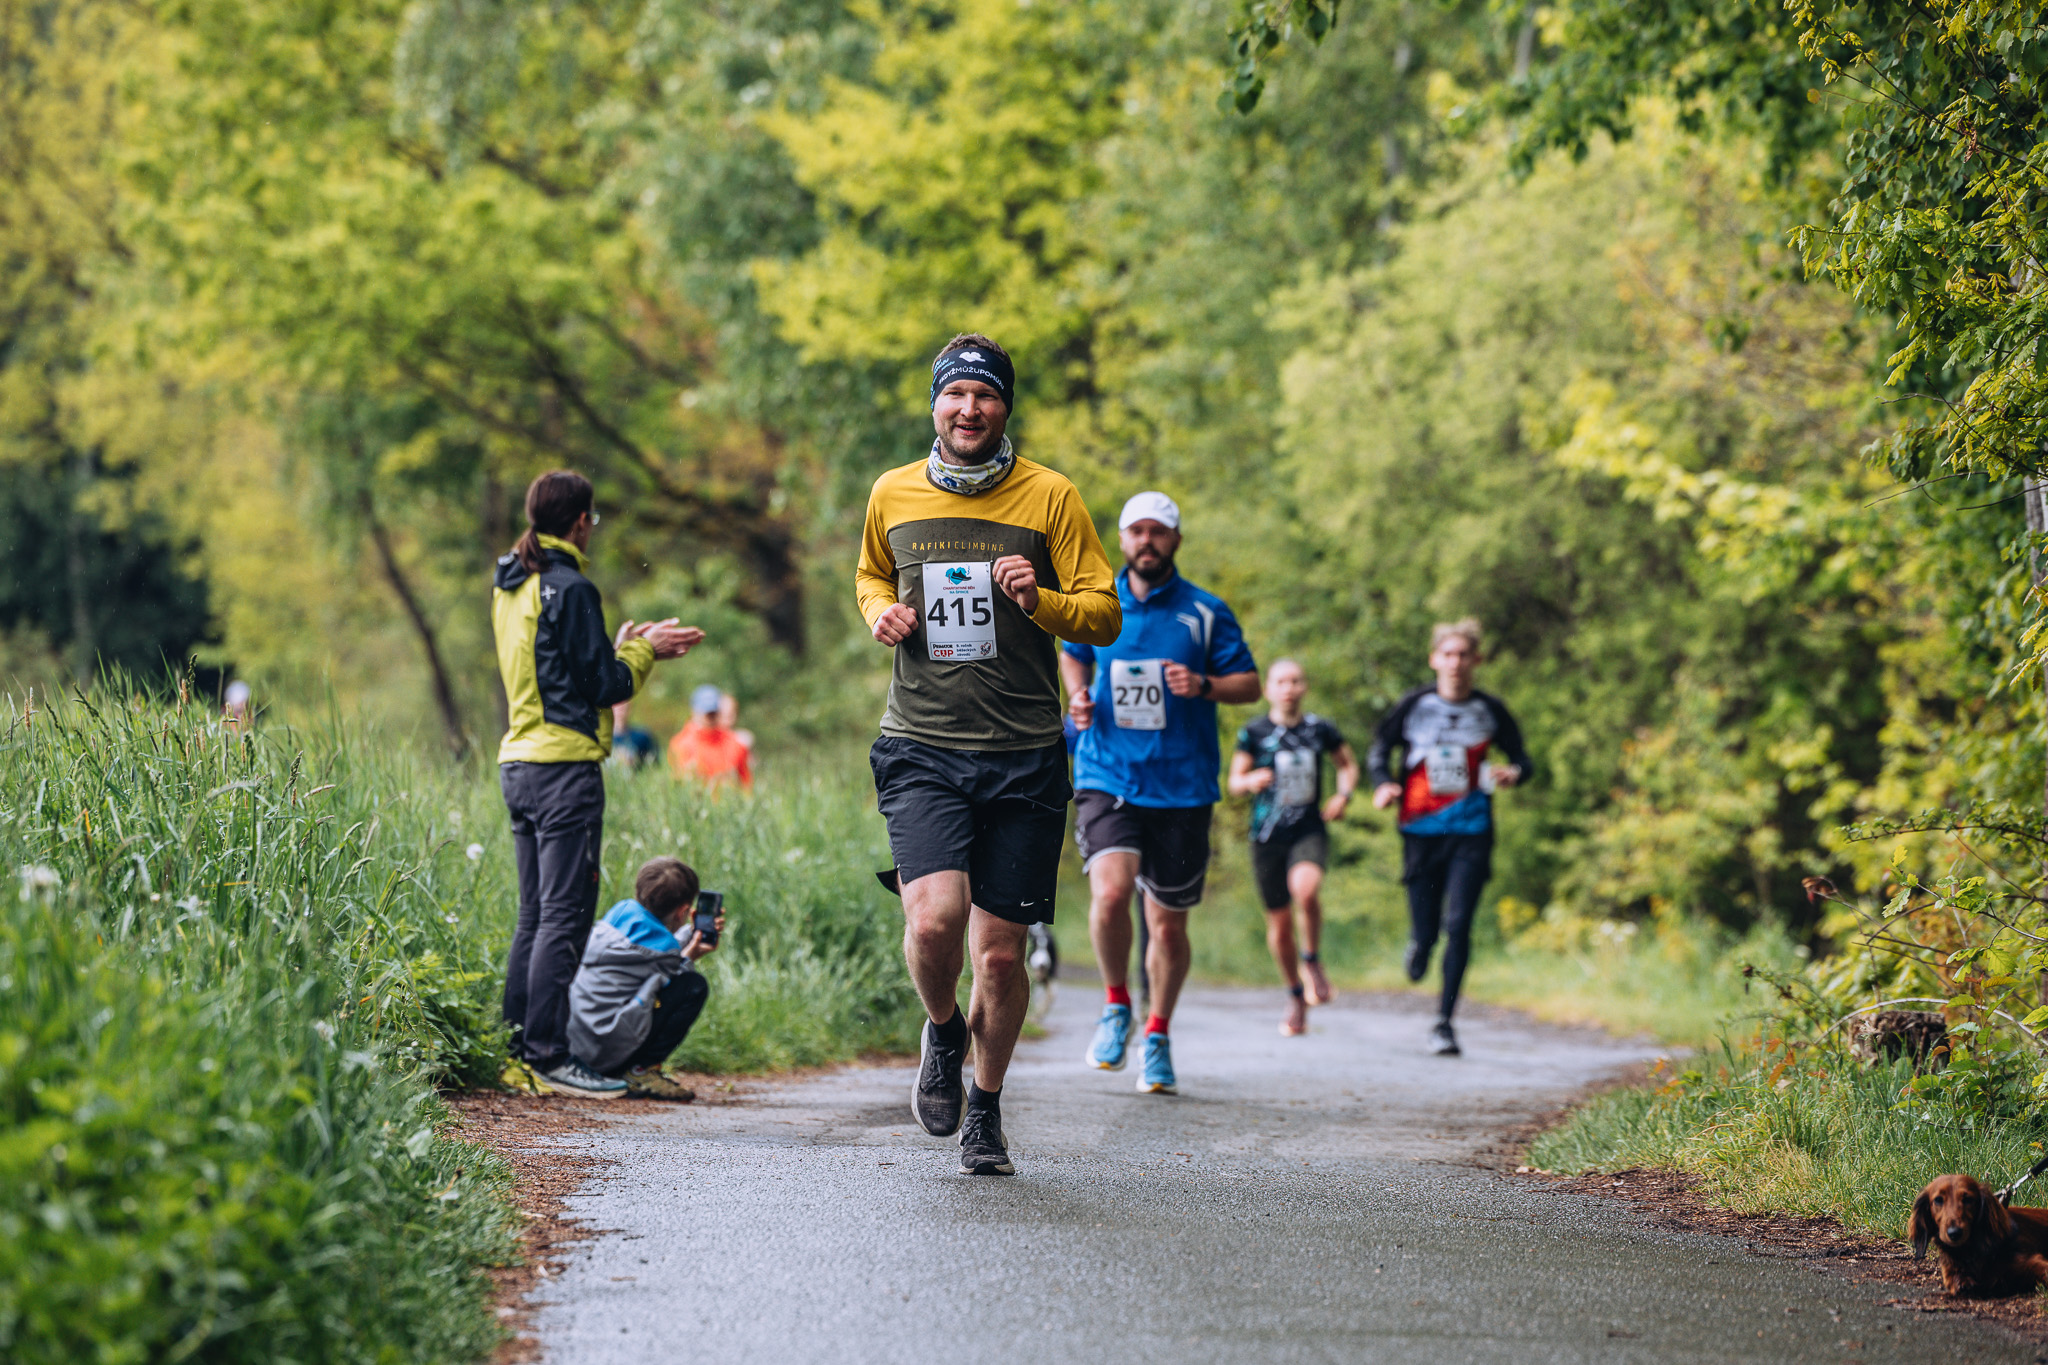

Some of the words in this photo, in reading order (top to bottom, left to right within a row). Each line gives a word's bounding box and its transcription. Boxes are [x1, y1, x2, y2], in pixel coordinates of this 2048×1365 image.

[912, 541, 951, 551] RAFIKI
[954, 541, 1004, 552] CLIMBING
[927, 597, 991, 627] 415
[1115, 686, 1161, 706] 270
